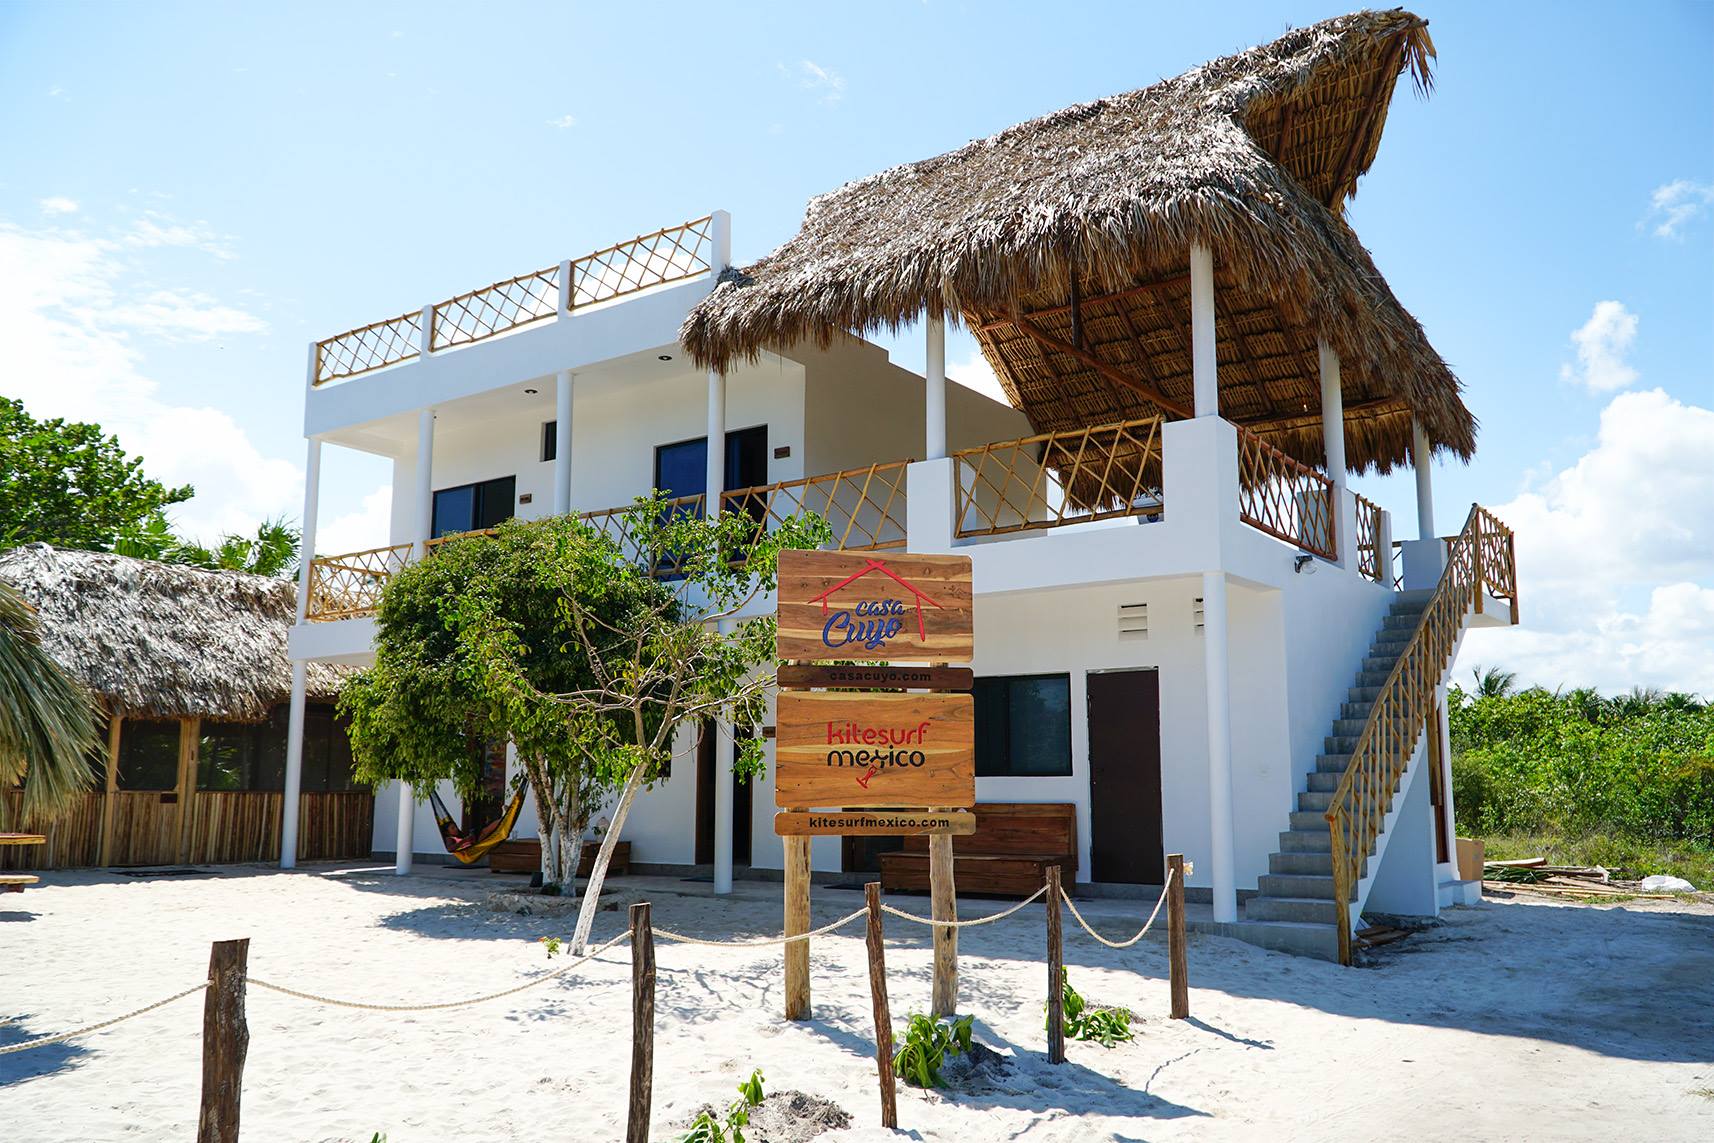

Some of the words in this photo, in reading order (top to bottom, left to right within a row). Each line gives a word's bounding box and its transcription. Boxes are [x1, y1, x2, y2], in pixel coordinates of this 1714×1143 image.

[855, 599, 905, 616] casa
[822, 611, 902, 649] Cuyo
[830, 671, 931, 683] casacuyo.com
[827, 721, 931, 745] kitesurf
[827, 745, 926, 768] mexico
[809, 816, 950, 828] kitesurfmexico.com
